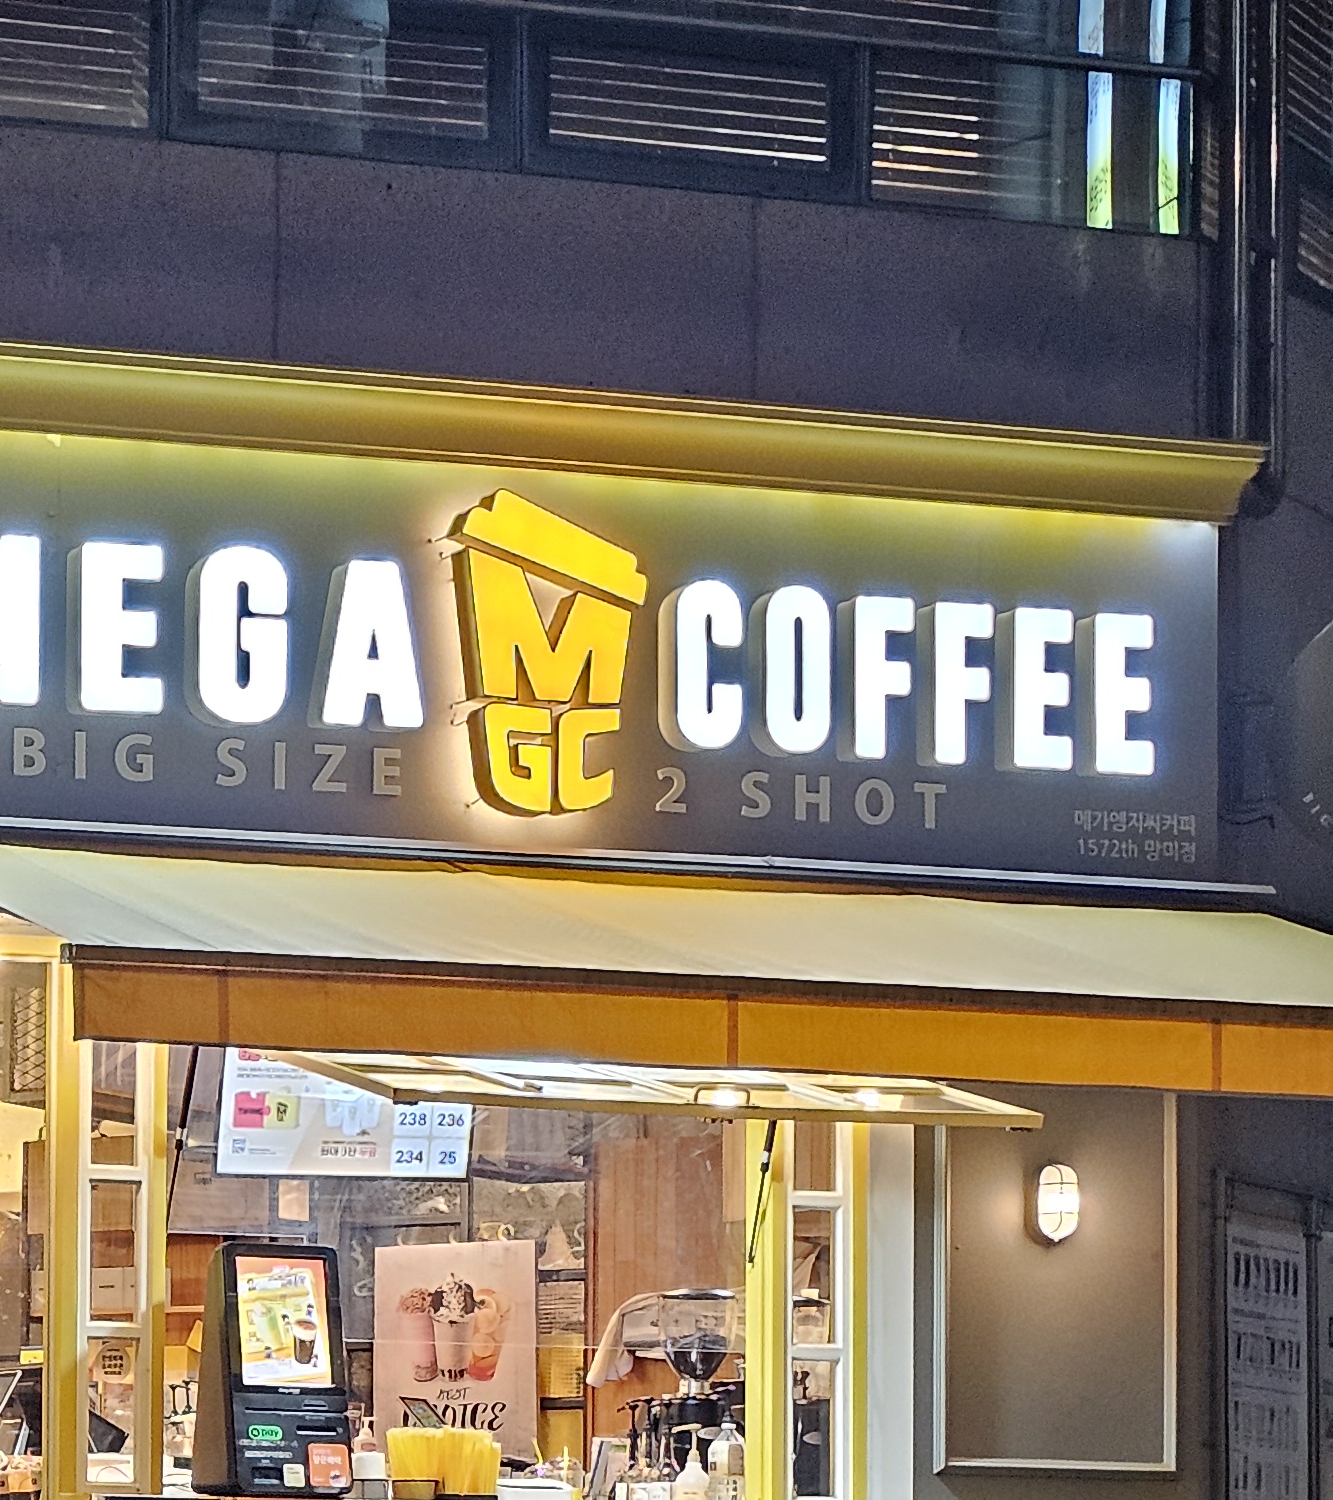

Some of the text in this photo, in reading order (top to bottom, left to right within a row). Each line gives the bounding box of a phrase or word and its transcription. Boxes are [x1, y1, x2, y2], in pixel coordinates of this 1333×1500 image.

[669, 579, 1157, 777] COFFEE
[14, 727, 402, 797] BIG SIZE
[655, 766, 948, 830] 2 SHOT
[1074, 810, 1195, 836] 메가엠지씨커피
[1077, 837, 1196, 863] 1572th 망미점
[399, 1111, 465, 1127] 238 236
[395, 1150, 457, 1165] 234 25
